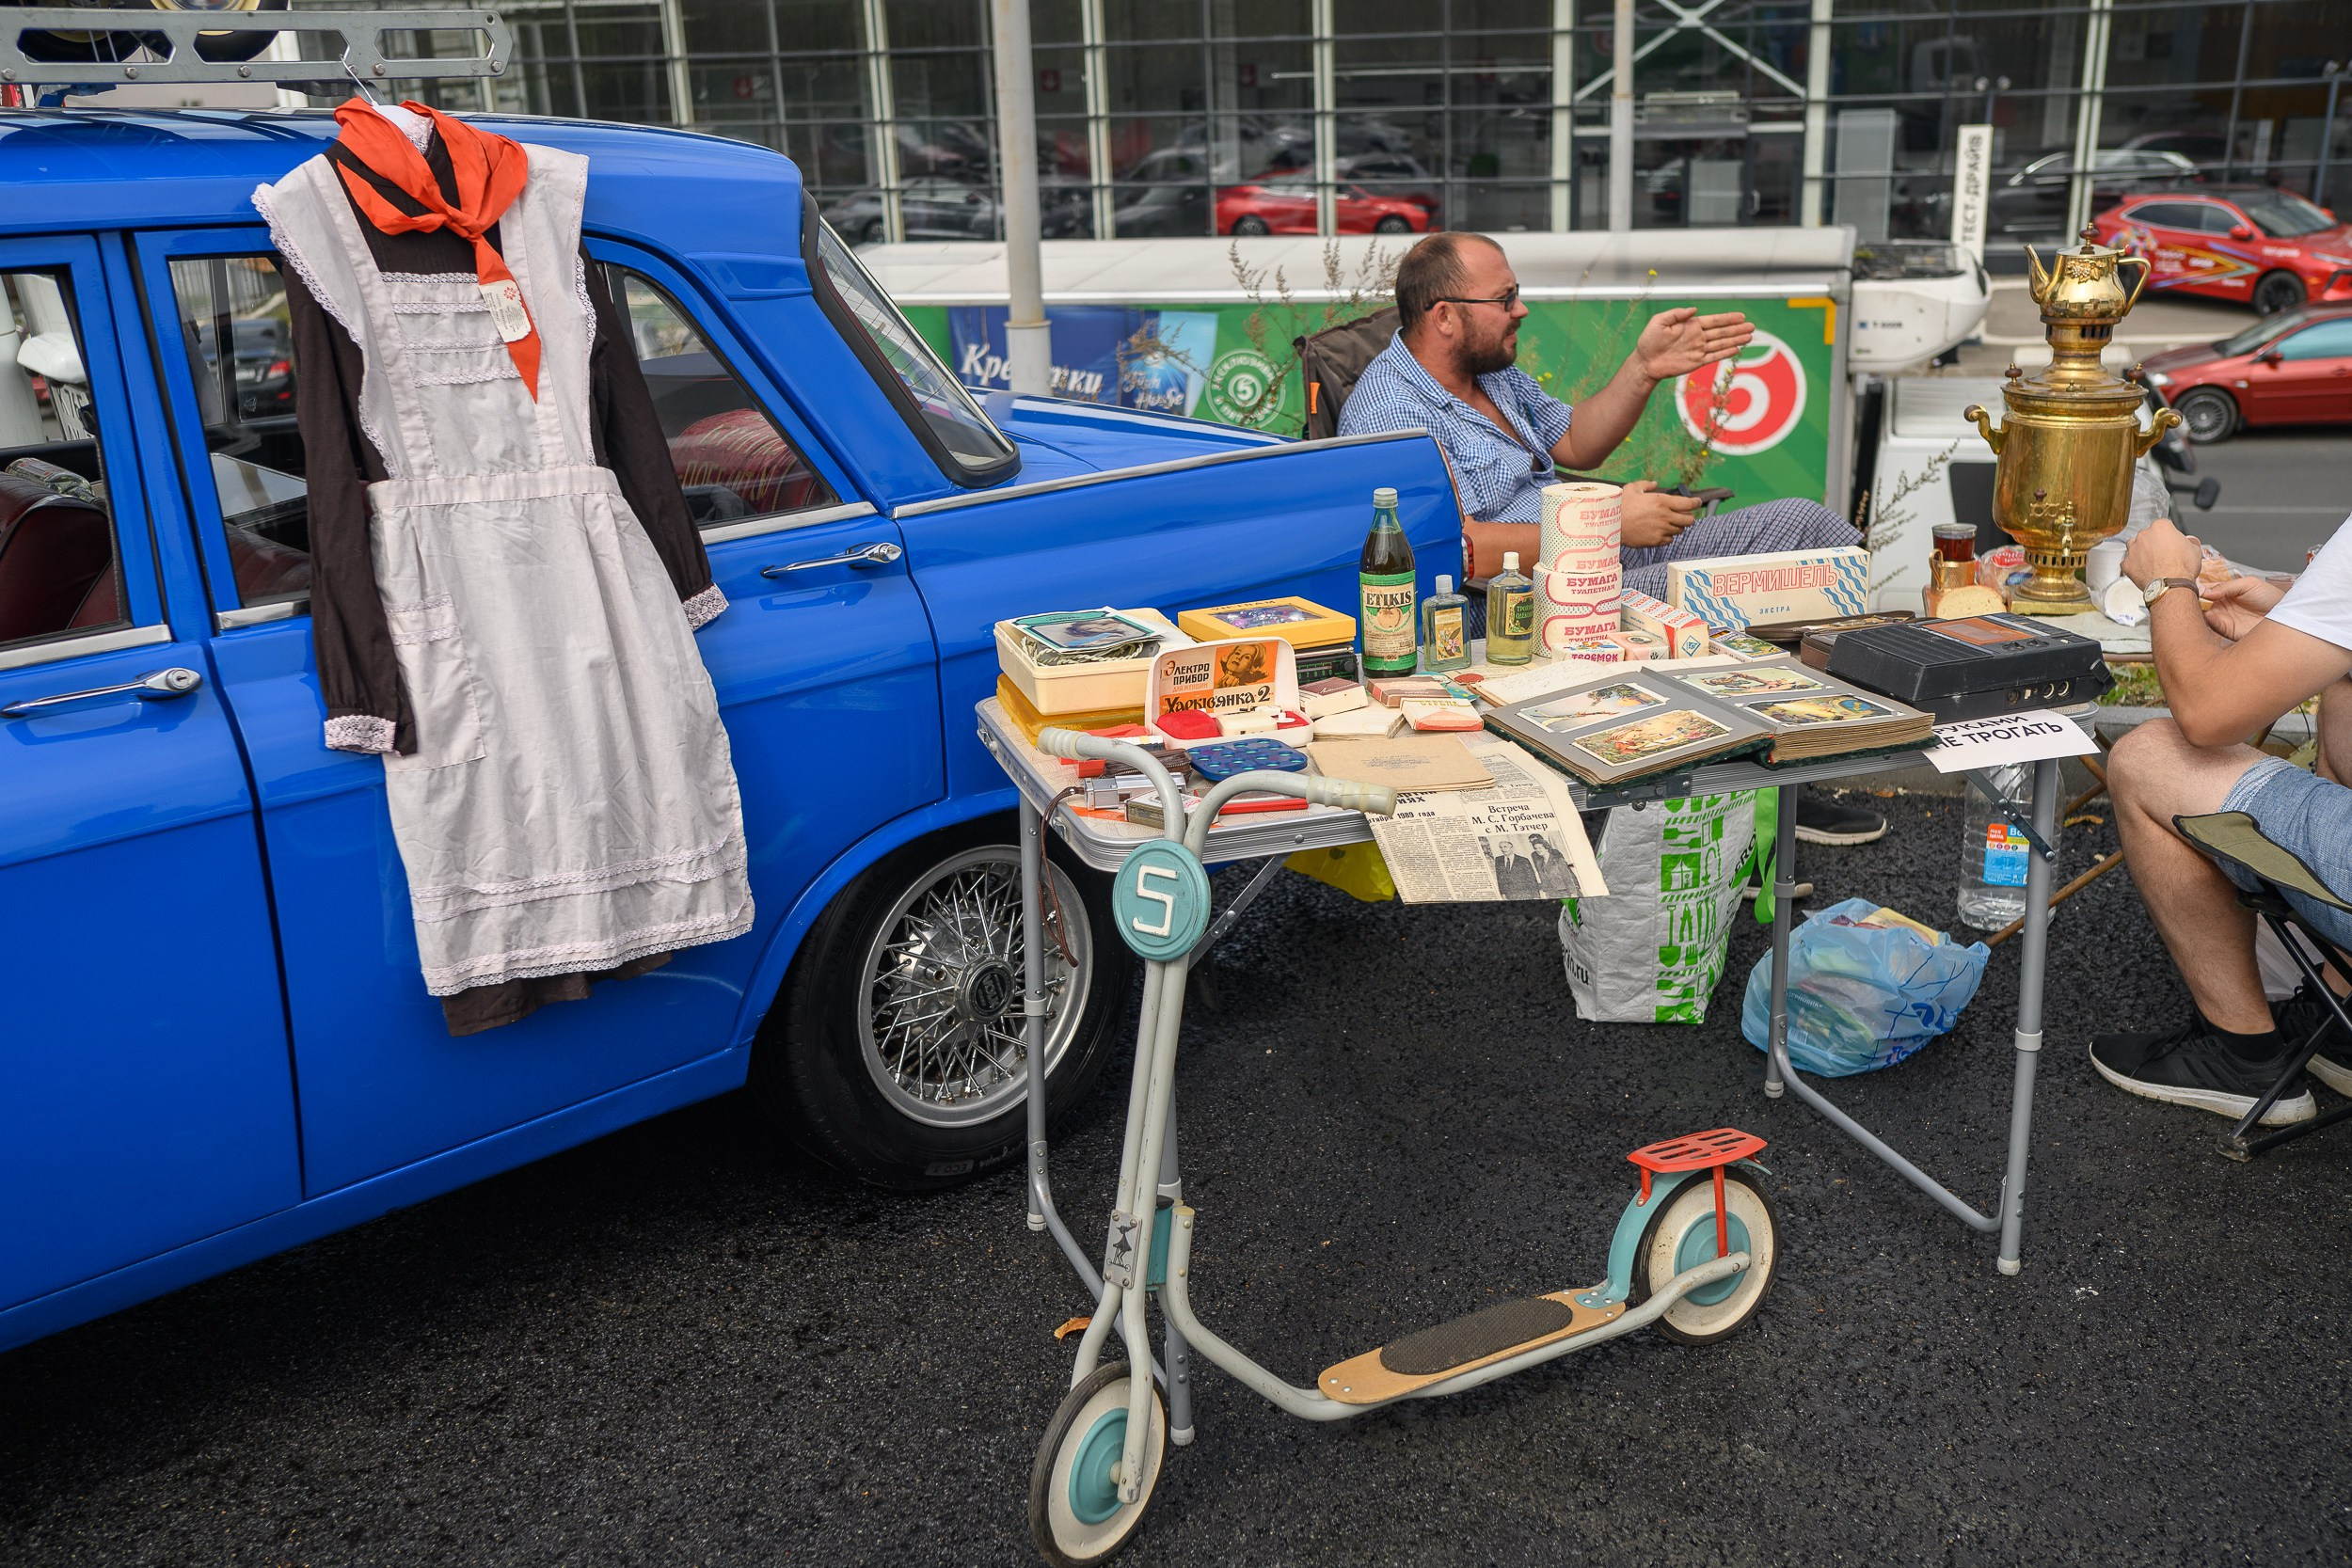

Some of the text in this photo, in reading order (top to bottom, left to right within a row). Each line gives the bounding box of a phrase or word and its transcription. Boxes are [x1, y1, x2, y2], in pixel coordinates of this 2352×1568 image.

[1566, 573, 1618, 588] БУМАГА
[1712, 564, 1838, 597] ВЕРМИШЕЛЬ
[1570, 584, 1615, 595] ТУАЛЕТНАЯ
[1366, 591, 1412, 607] ETIKIS
[1759, 606, 1791, 615] ЭКСТРА
[1564, 621, 1617, 637] БУМАГА
[1164, 660, 1210, 677] ЭЛЕКТРО
[1173, 673, 1210, 686] ПРИБОР
[1257, 685, 1271, 703] 2
[1962, 721, 2063, 744] ТРОГАТЬ
[1397, 811, 1415, 819] 1989
[1487, 804, 1531, 815] Встреча
[1471, 812, 1555, 825] М. С. Горбачева
[1495, 824, 1509, 833] М.
[1511, 822, 1549, 832] Тэтчер
